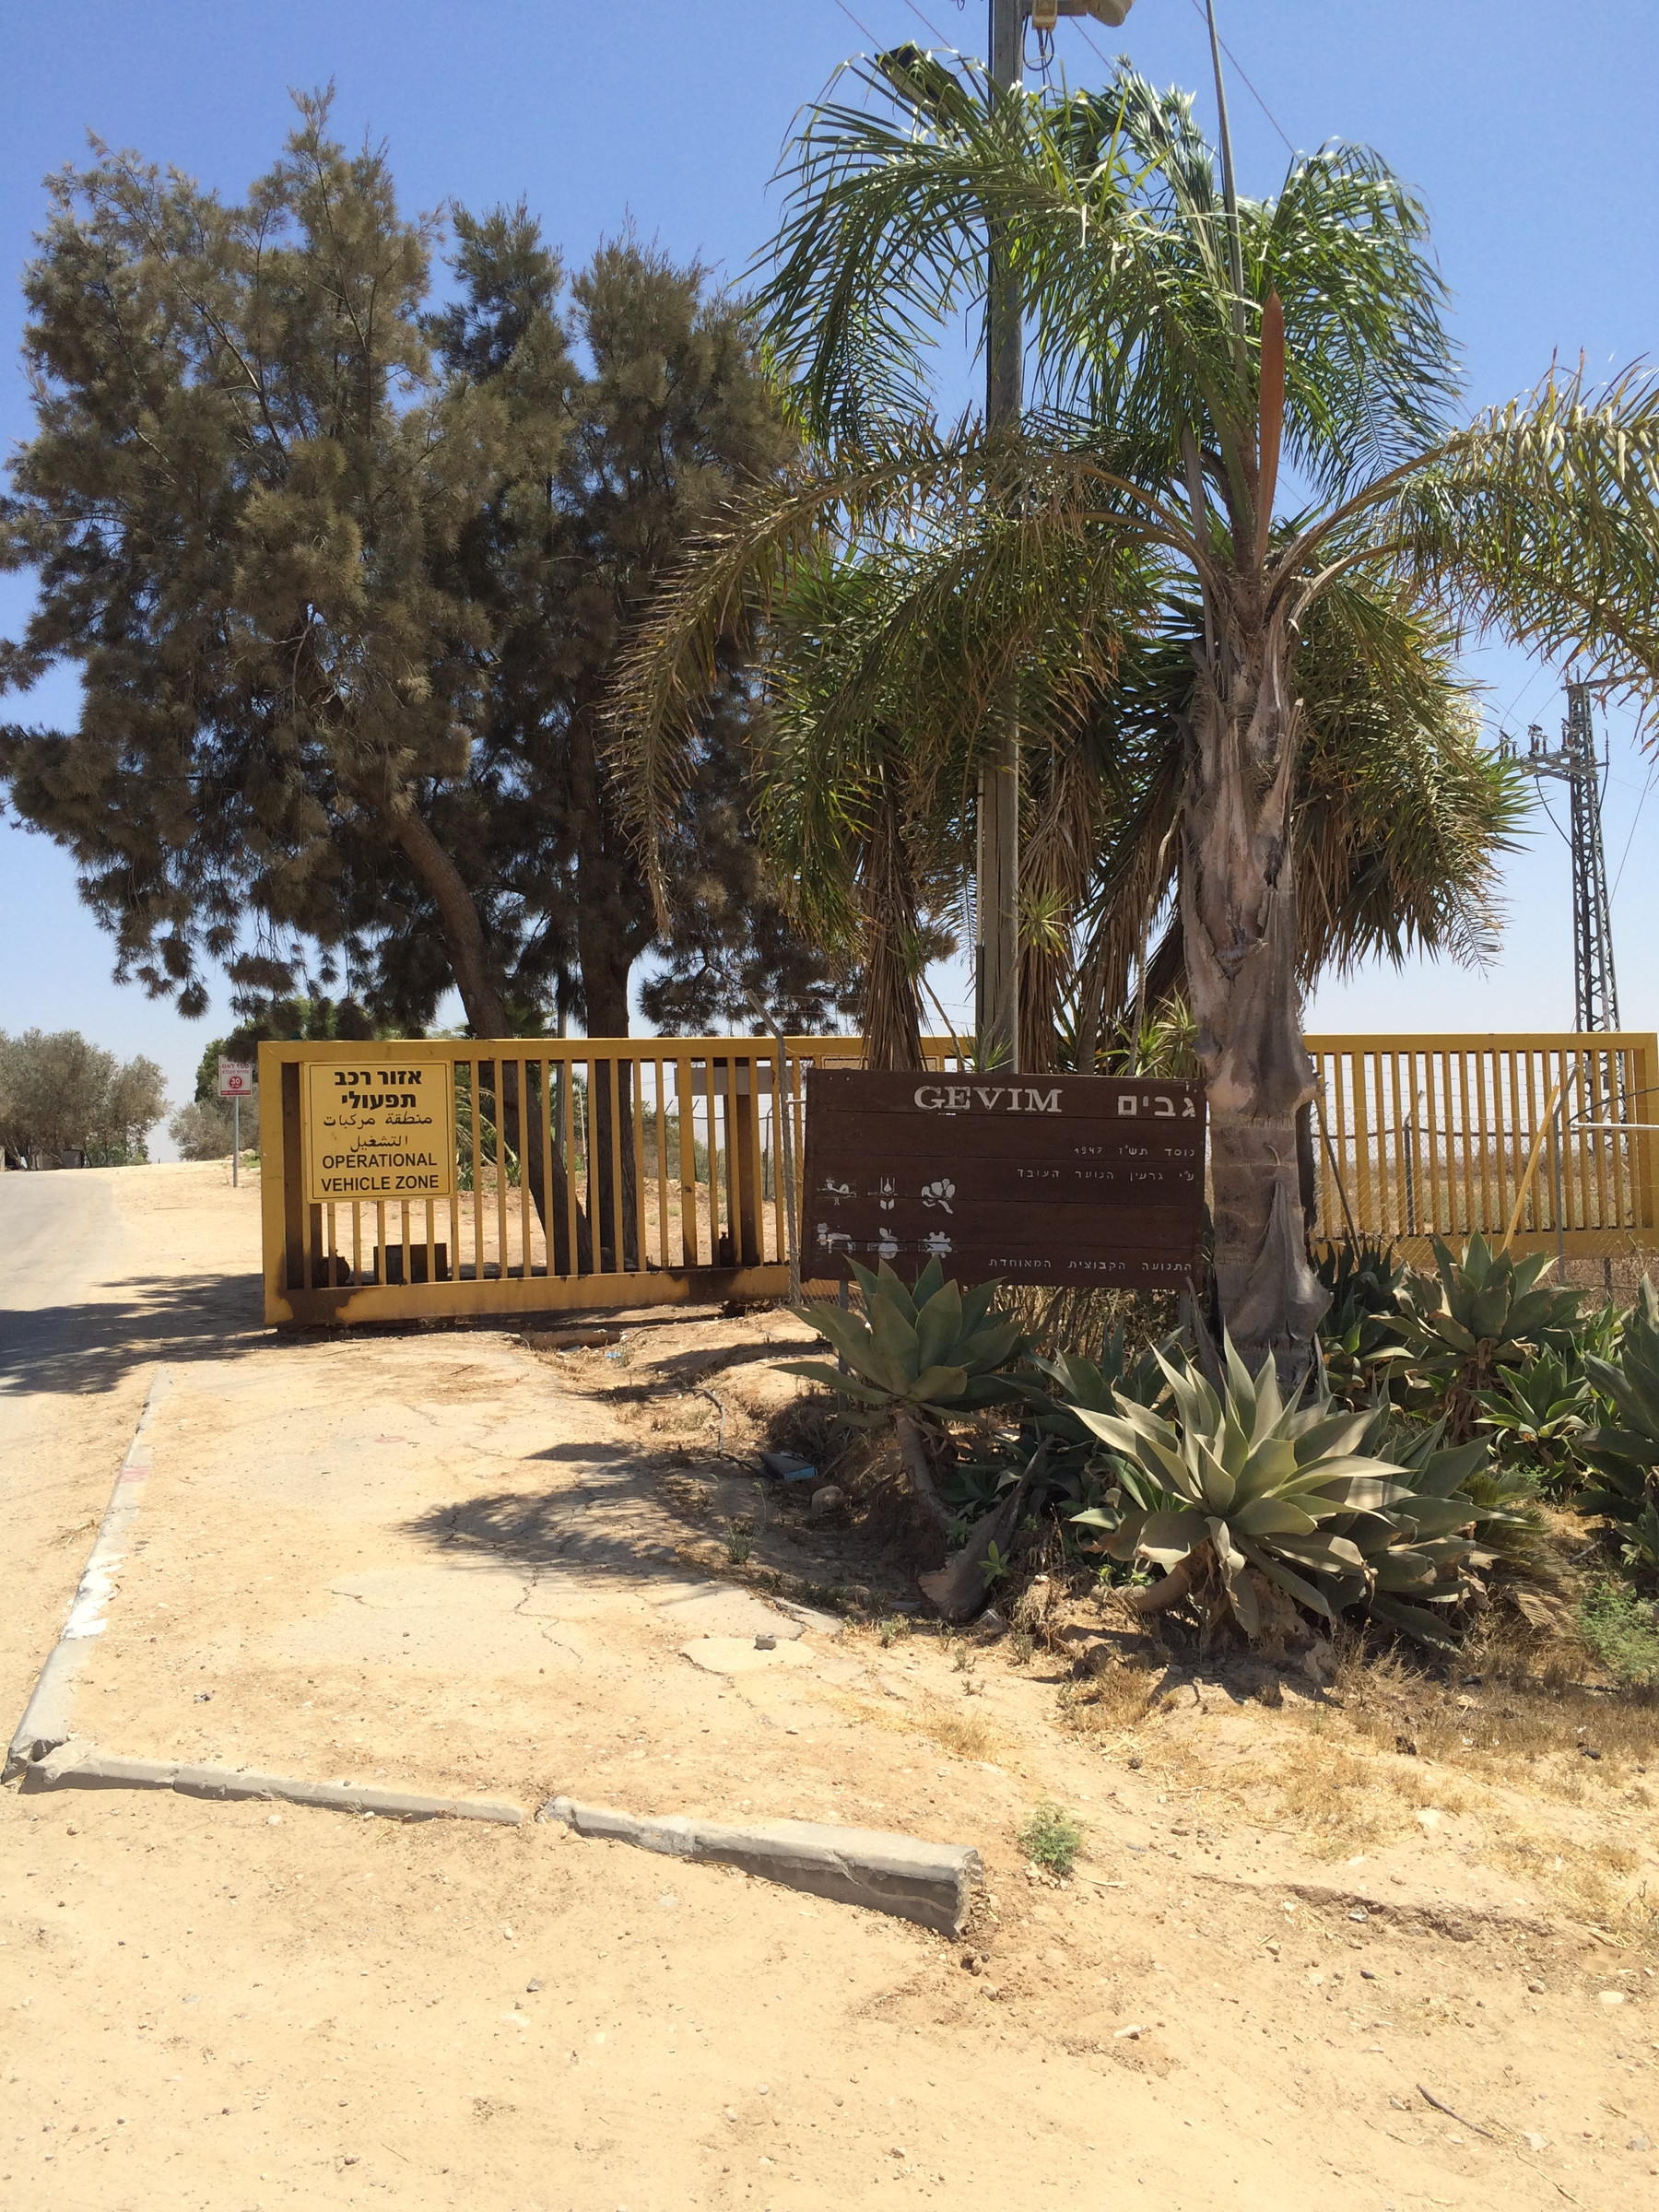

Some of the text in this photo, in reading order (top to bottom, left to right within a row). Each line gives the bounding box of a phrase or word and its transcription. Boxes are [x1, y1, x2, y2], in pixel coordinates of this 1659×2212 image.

[335, 1070, 422, 1086] אזור רכב
[341, 1090, 417, 1111] תפעולי
[913, 1086, 1064, 1113] GEVIM
[1117, 1095, 1196, 1118] גבים
[323, 1111, 433, 1130] منطقة مركبات
[350, 1135, 408, 1153] التشغيل
[1074, 1146, 1103, 1156] 1947
[323, 1152, 438, 1170] OPERATIONAL
[1164, 1148, 1195, 1158] נוסד
[1018, 1169, 1060, 1179] העובד
[1075, 1171, 1114, 1181] הנוער
[1129, 1171, 1164, 1182] גרעין
[321, 1174, 440, 1192] VEHICLE ZONE
[988, 1258, 1193, 1272] התנועה הקבוצית המאוחדת
